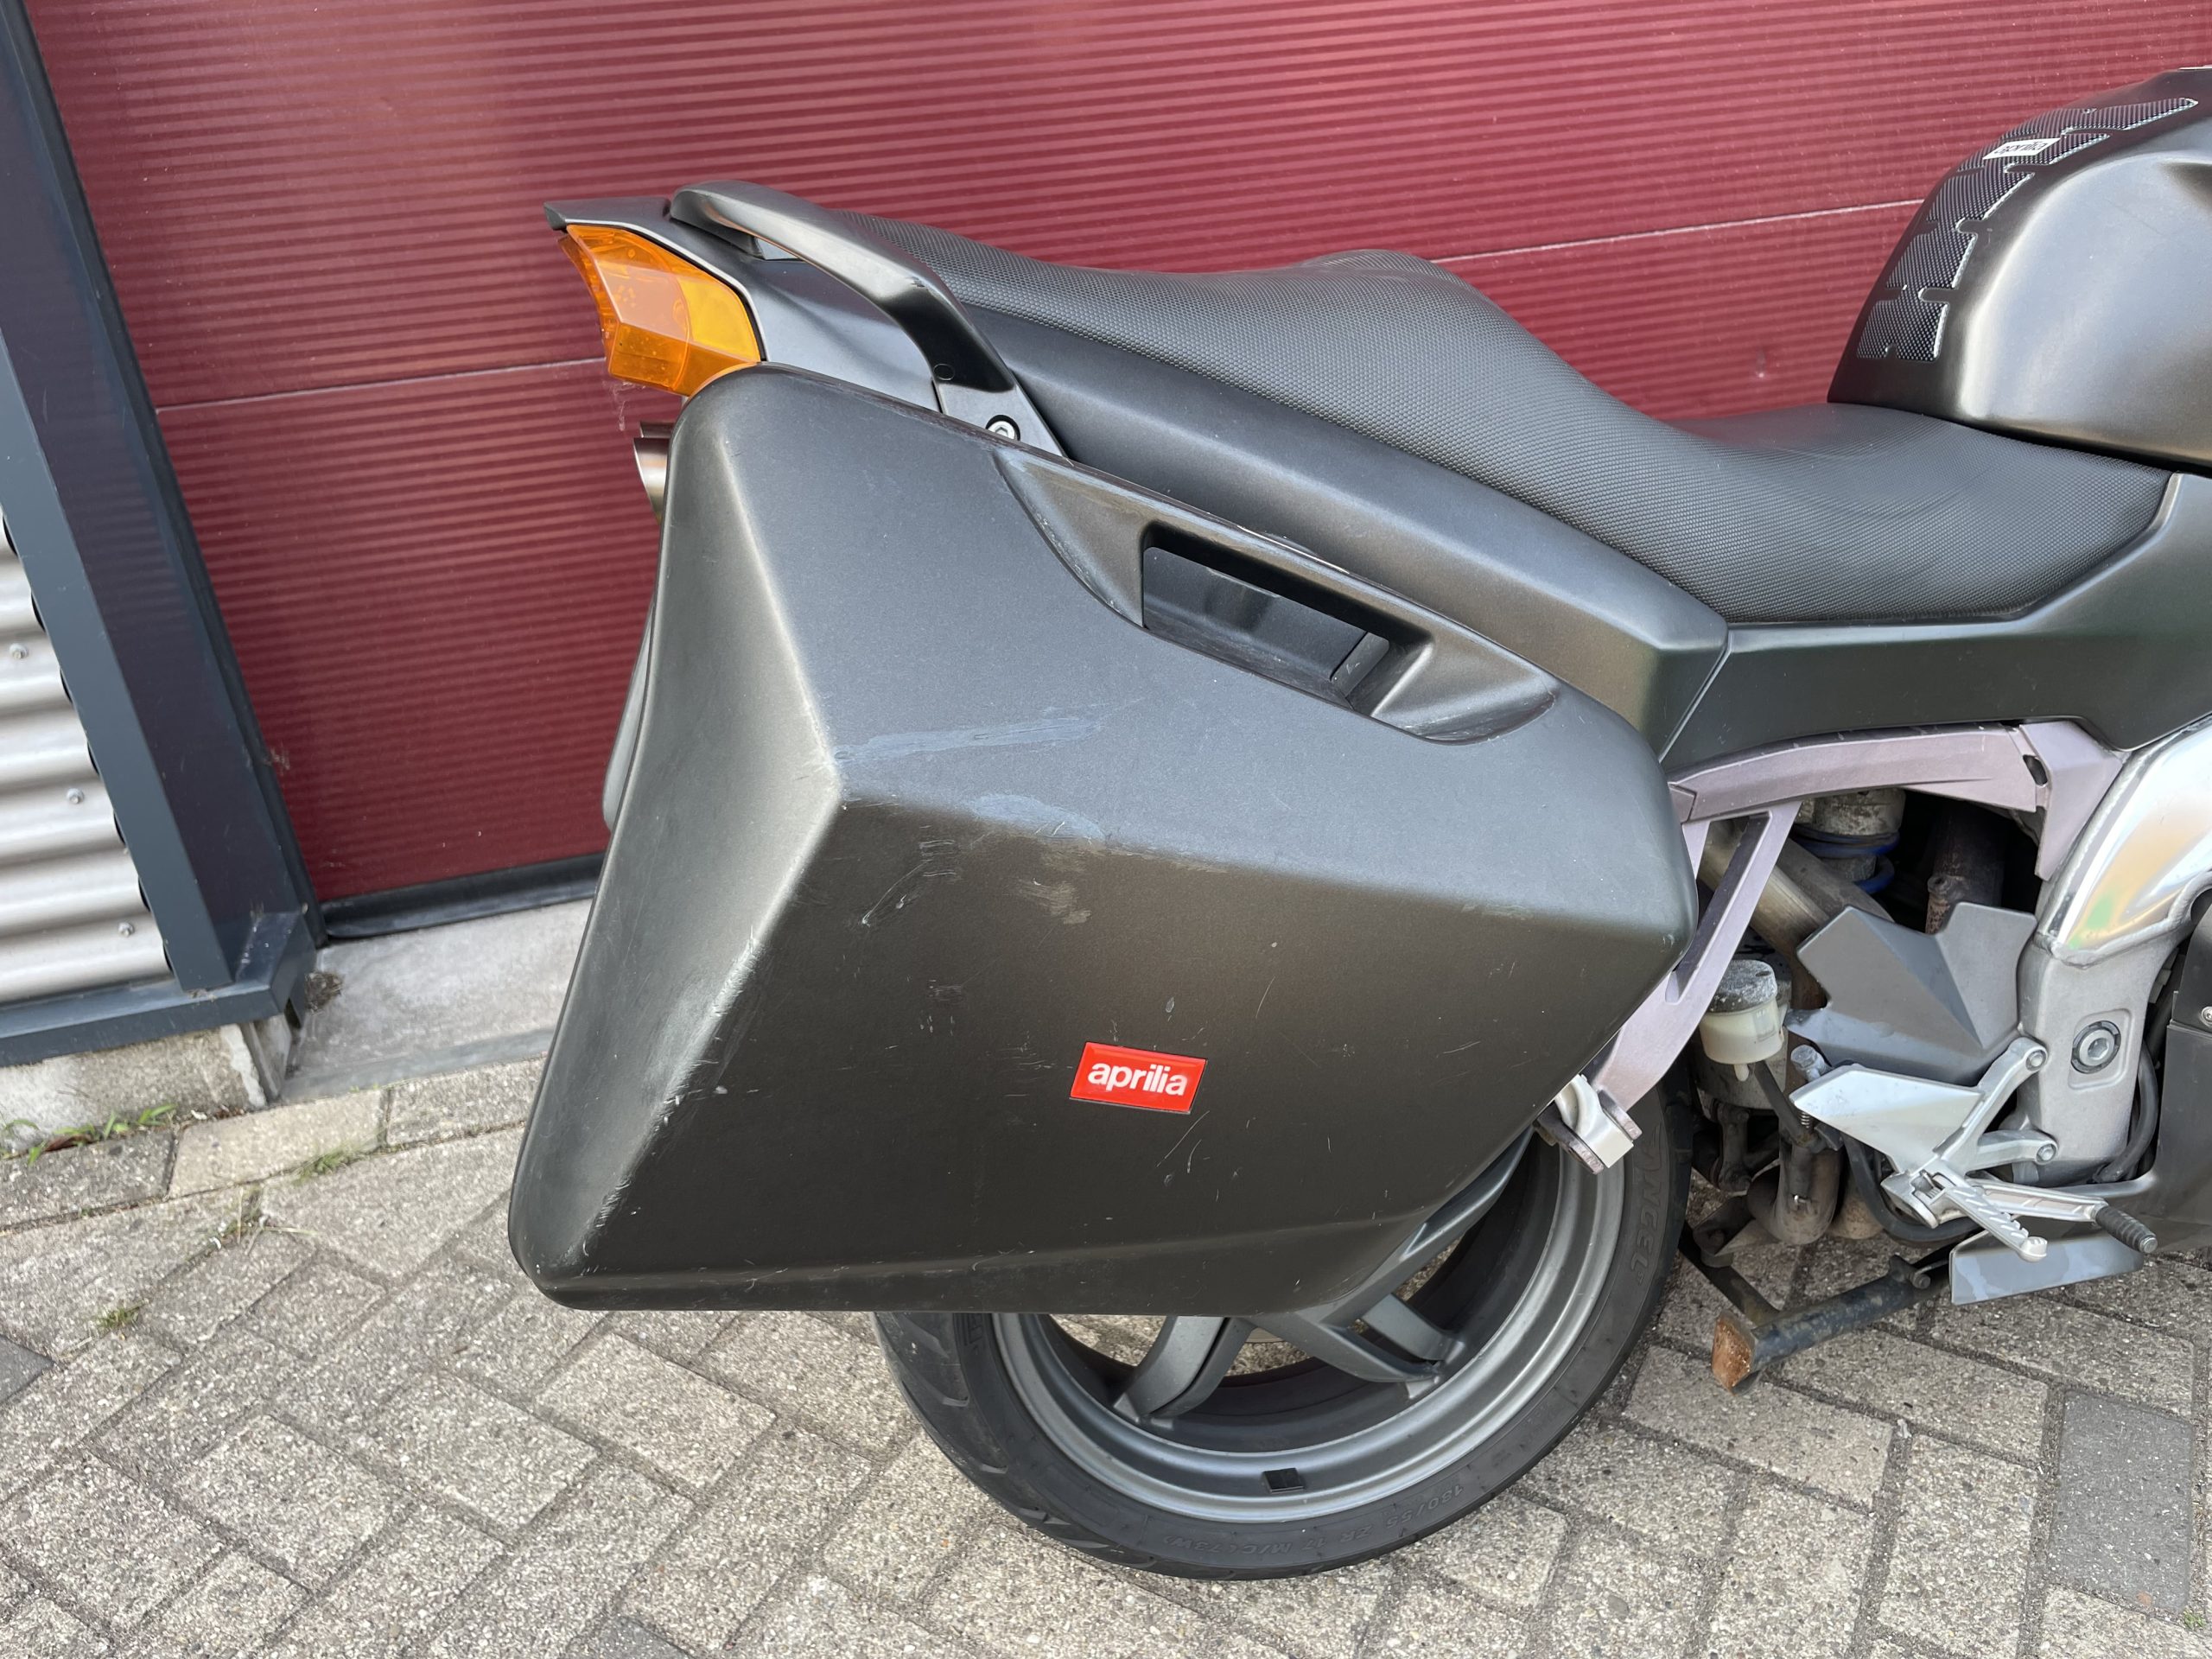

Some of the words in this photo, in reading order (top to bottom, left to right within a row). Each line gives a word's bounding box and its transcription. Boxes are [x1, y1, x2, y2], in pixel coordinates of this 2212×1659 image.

[1088, 1063, 1188, 1096] aprilia
[1386, 1484, 1465, 1529] 180/55
[1301, 1536, 1327, 1550] 17
[1340, 1524, 1373, 1542] ZR
